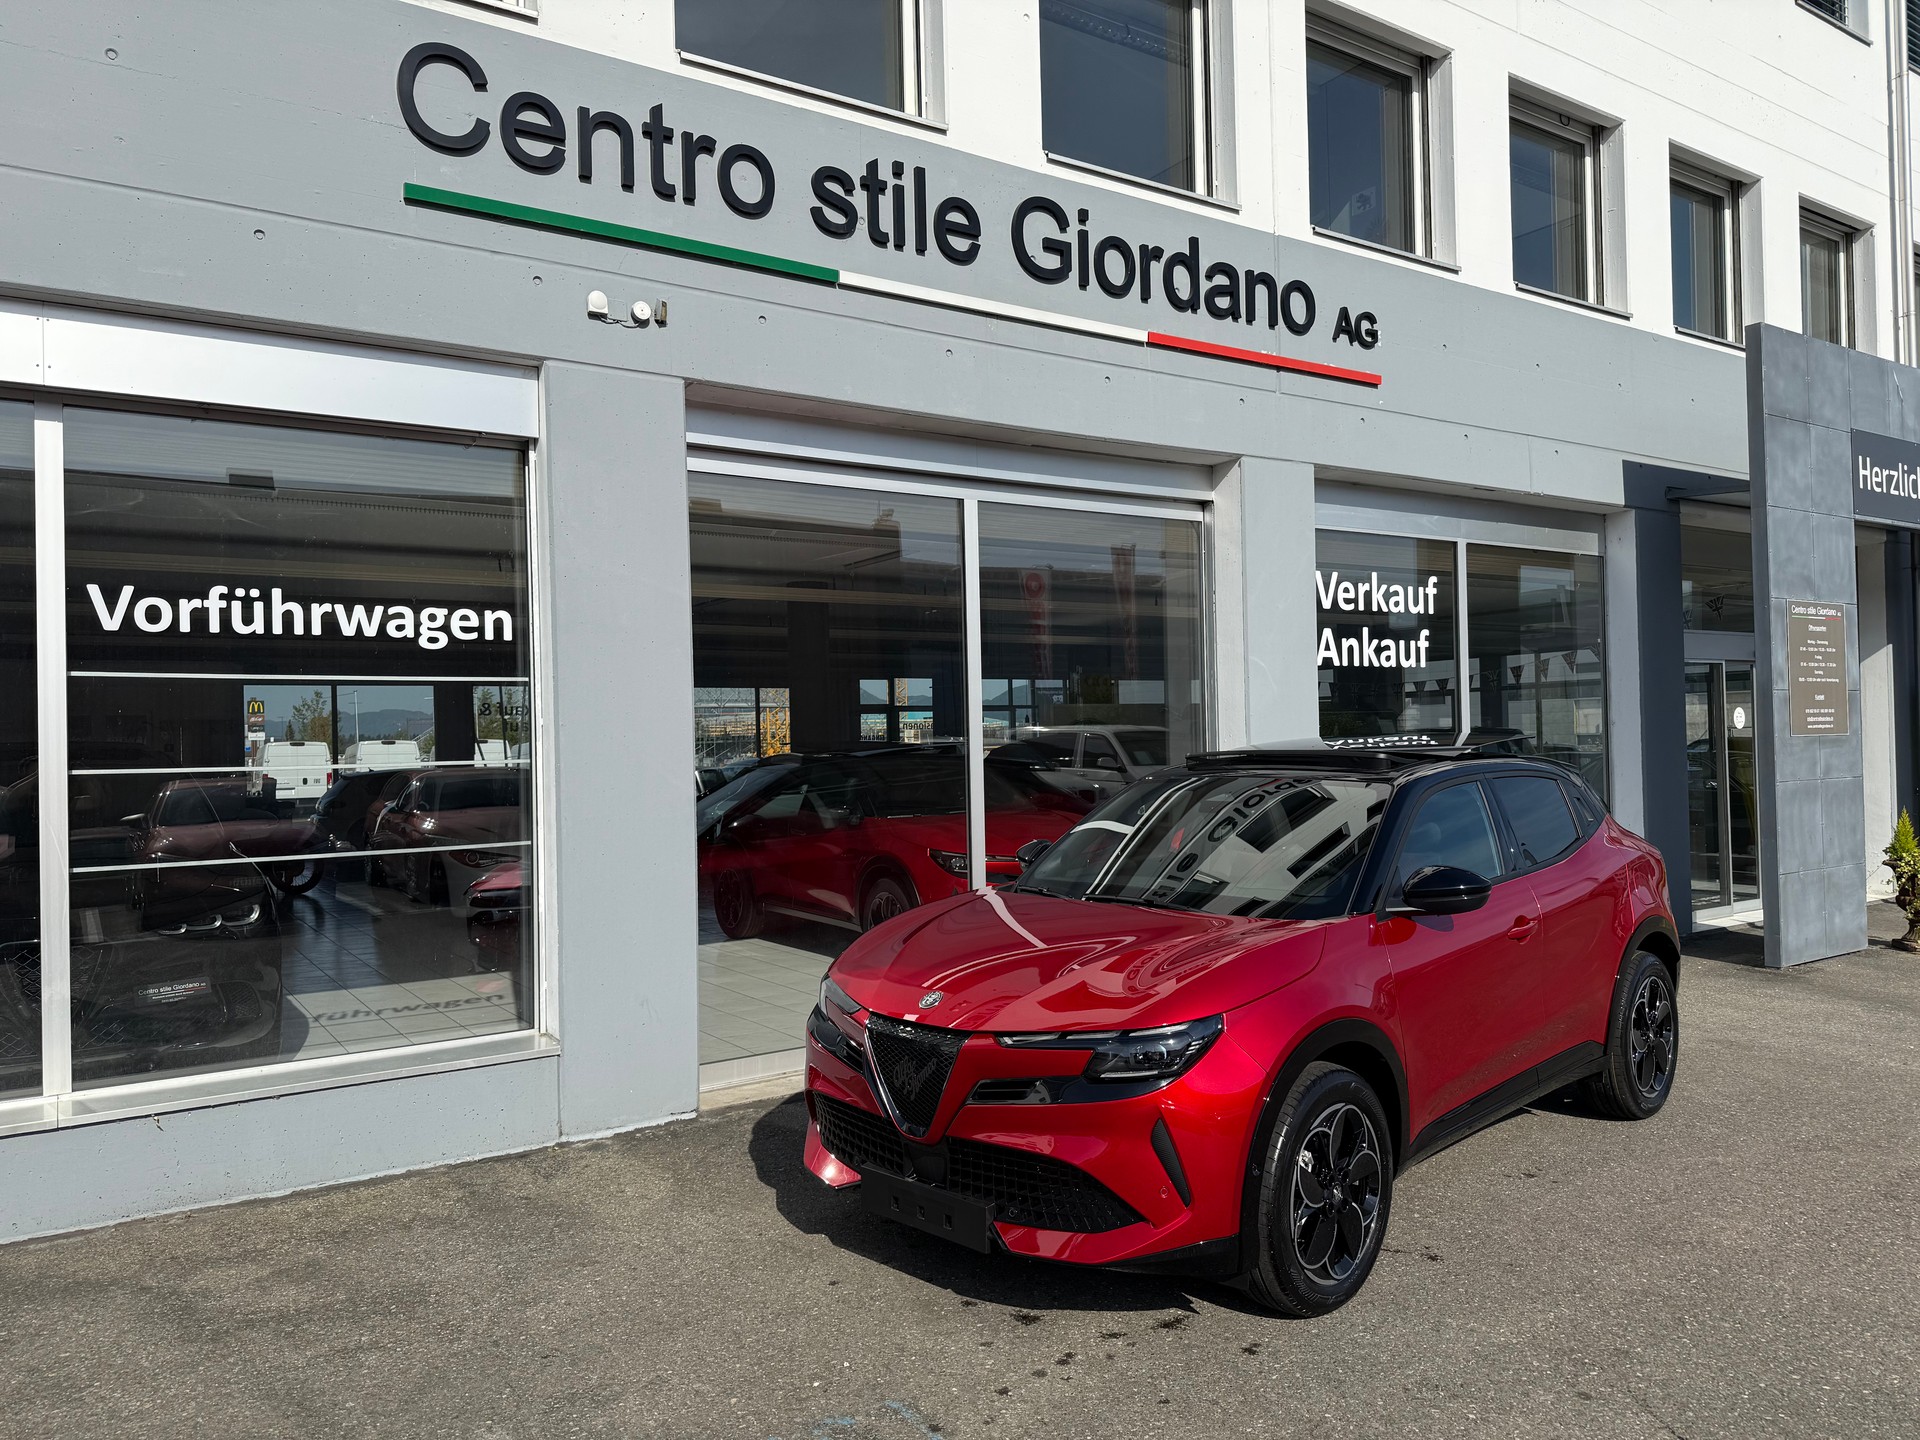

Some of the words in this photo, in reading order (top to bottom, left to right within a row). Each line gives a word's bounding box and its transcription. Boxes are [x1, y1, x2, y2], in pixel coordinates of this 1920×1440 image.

[397, 42, 776, 219] Centro
[811, 159, 981, 266] stile
[1011, 196, 1317, 337] Giordano
[1332, 305, 1379, 349] AG
[1315, 570, 1438, 615] Verkauf
[1791, 604, 1807, 614] Centro
[86, 583, 514, 650] Vorführwagen
[1316, 626, 1430, 668] Ankauf
[137, 987, 159, 996] Centro
[160, 985, 172, 993] stile
[172, 982, 200, 991] Giordano
